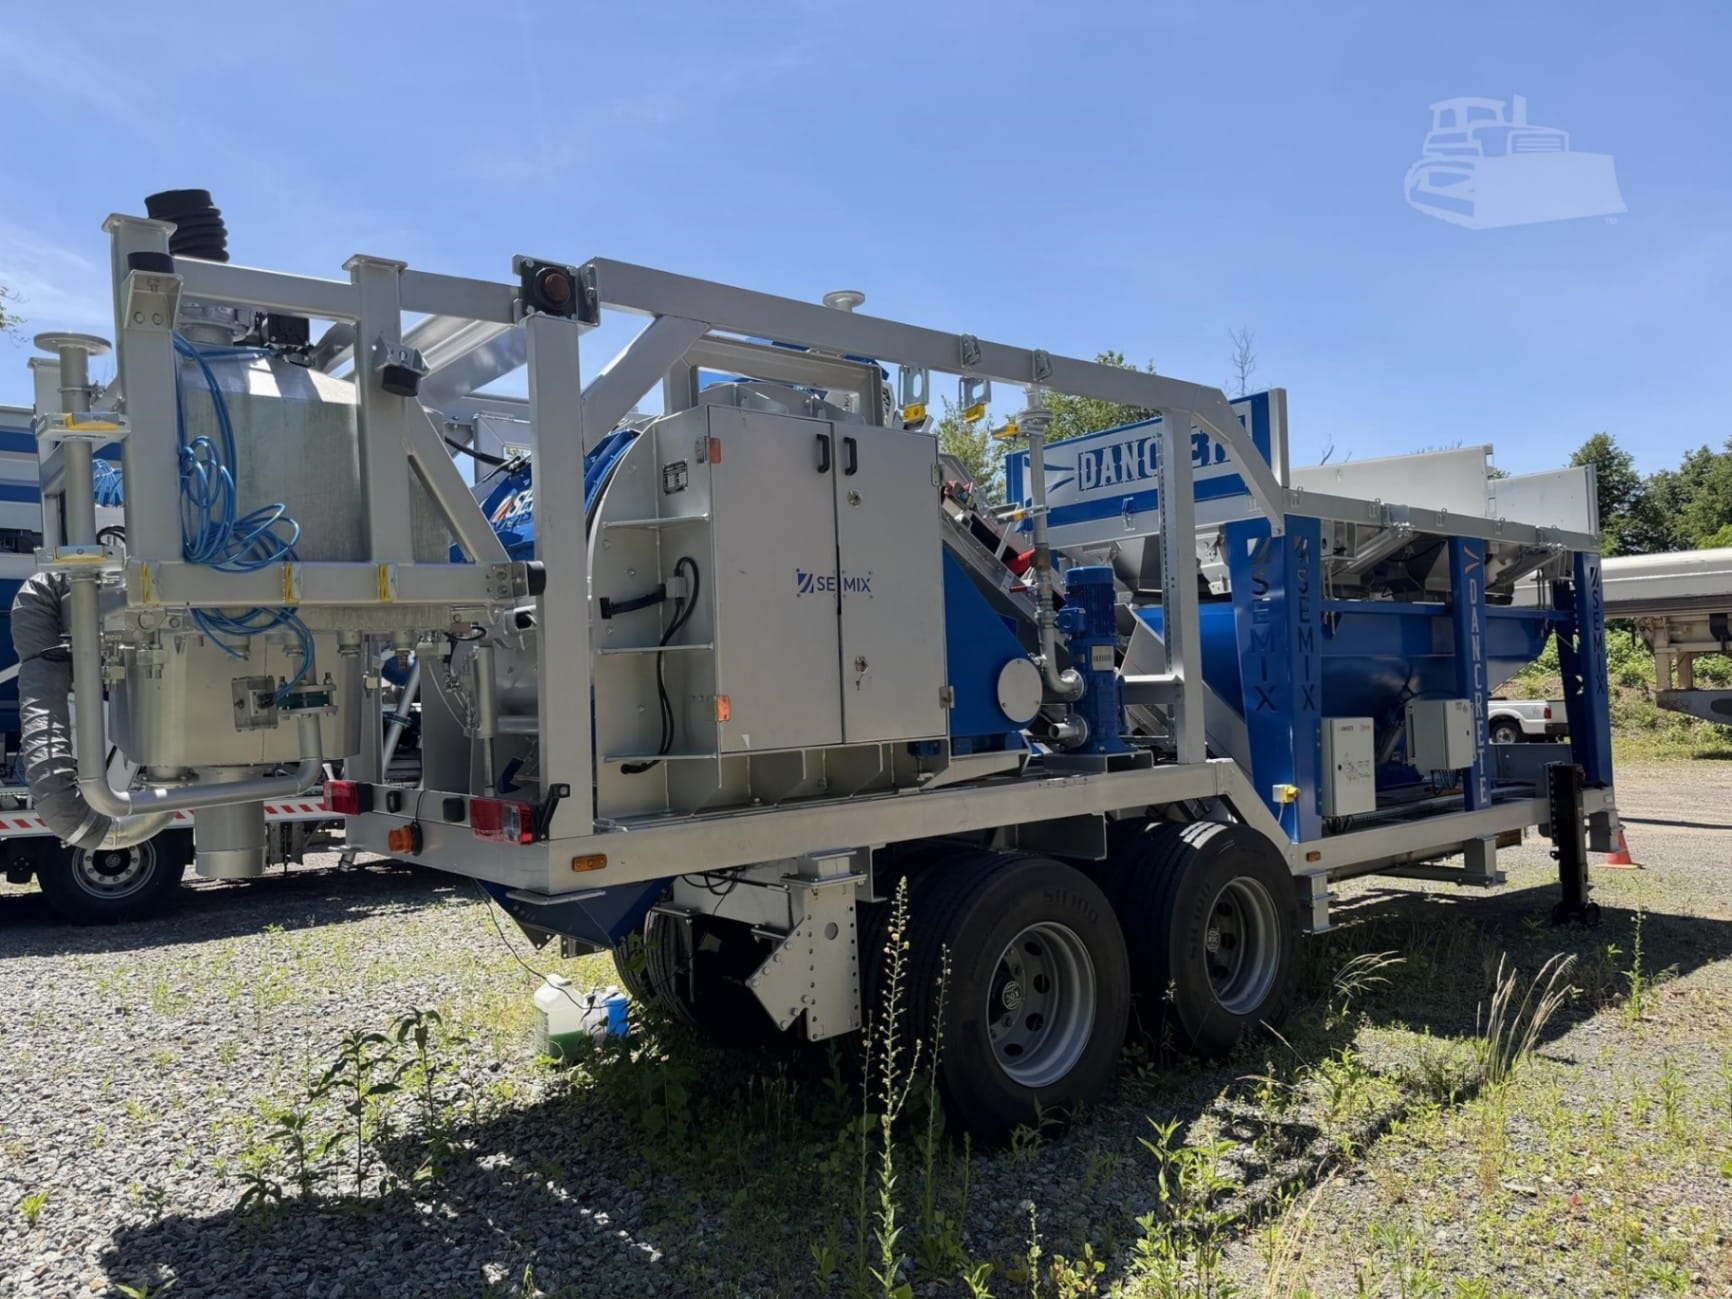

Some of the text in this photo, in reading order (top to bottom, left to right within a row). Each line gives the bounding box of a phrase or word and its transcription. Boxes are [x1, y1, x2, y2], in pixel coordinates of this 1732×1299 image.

[816, 575, 872, 593] SEMIX
[1296, 568, 1316, 712] SEMIX
[1591, 589, 1605, 695] SEMIX
[1469, 578, 1487, 804] DANCRETE
